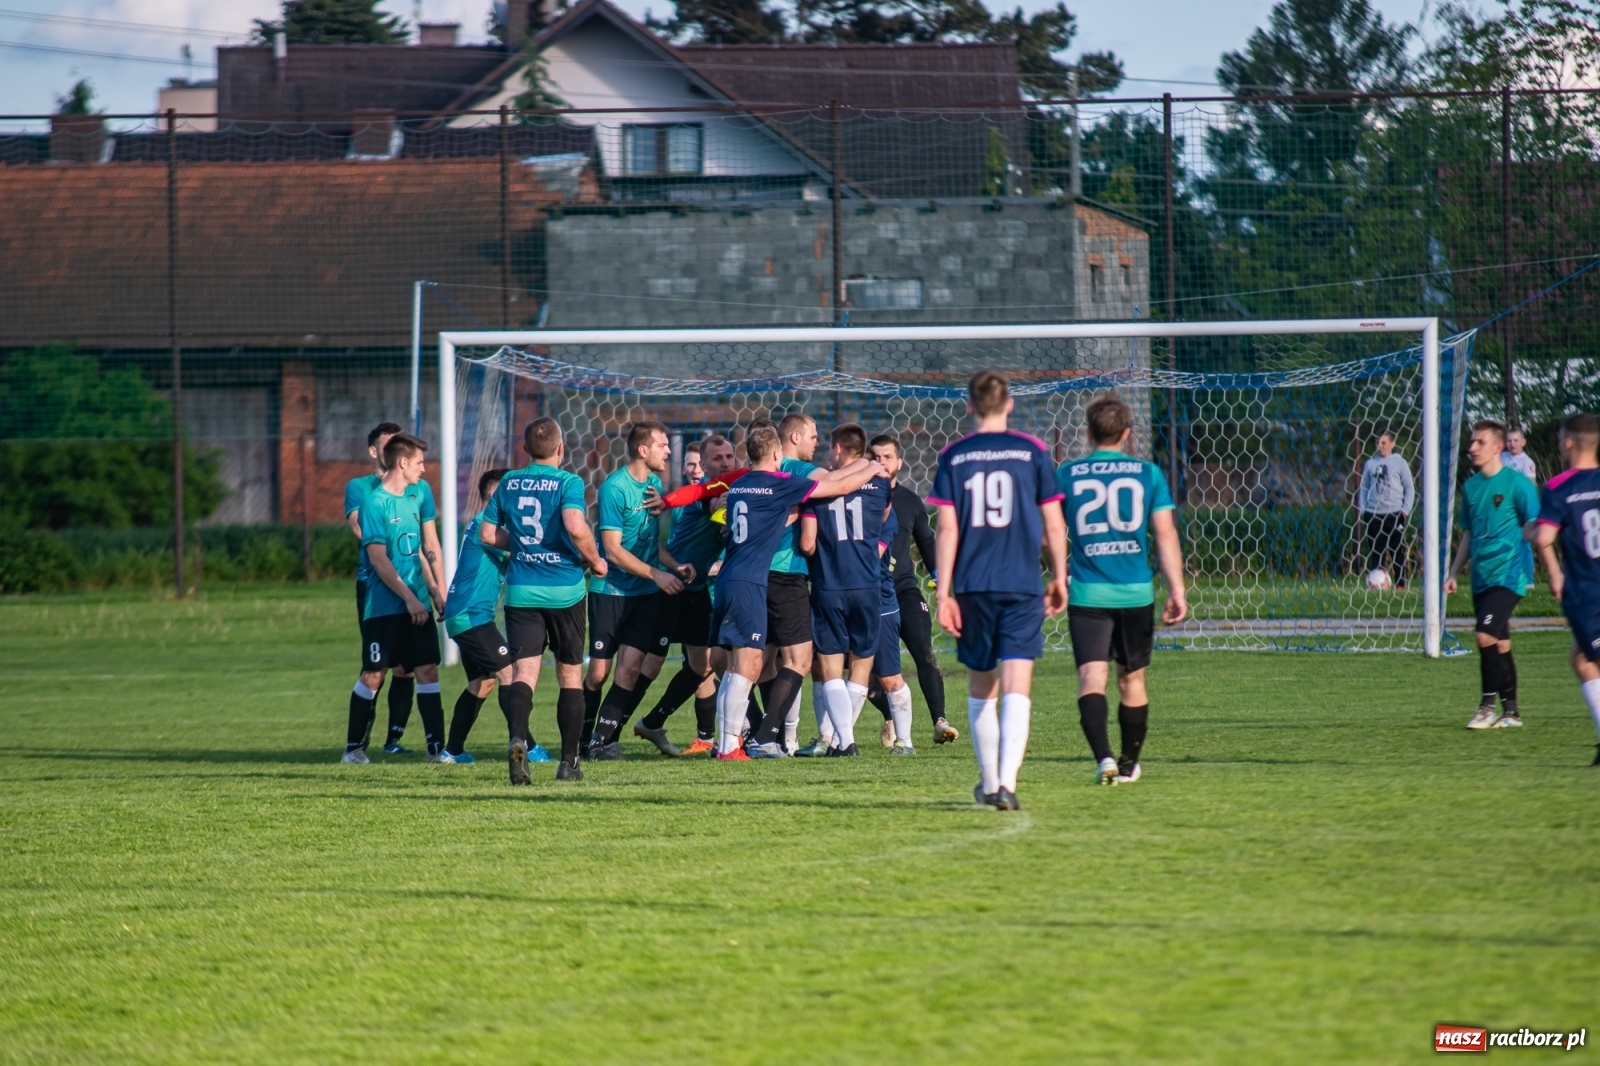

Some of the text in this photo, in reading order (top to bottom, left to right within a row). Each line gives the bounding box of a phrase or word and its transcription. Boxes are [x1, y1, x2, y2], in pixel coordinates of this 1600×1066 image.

[506, 479, 520, 491] KS
[1070, 461, 1143, 477] KS CZARNI
[517, 496, 544, 546] 3
[828, 496, 864, 541] 11
[963, 470, 1014, 529] 19
[1073, 477, 1145, 536] 20
[731, 500, 748, 544] 6
[1483, 613, 1494, 625] 2
[370, 642, 381, 662] 8
